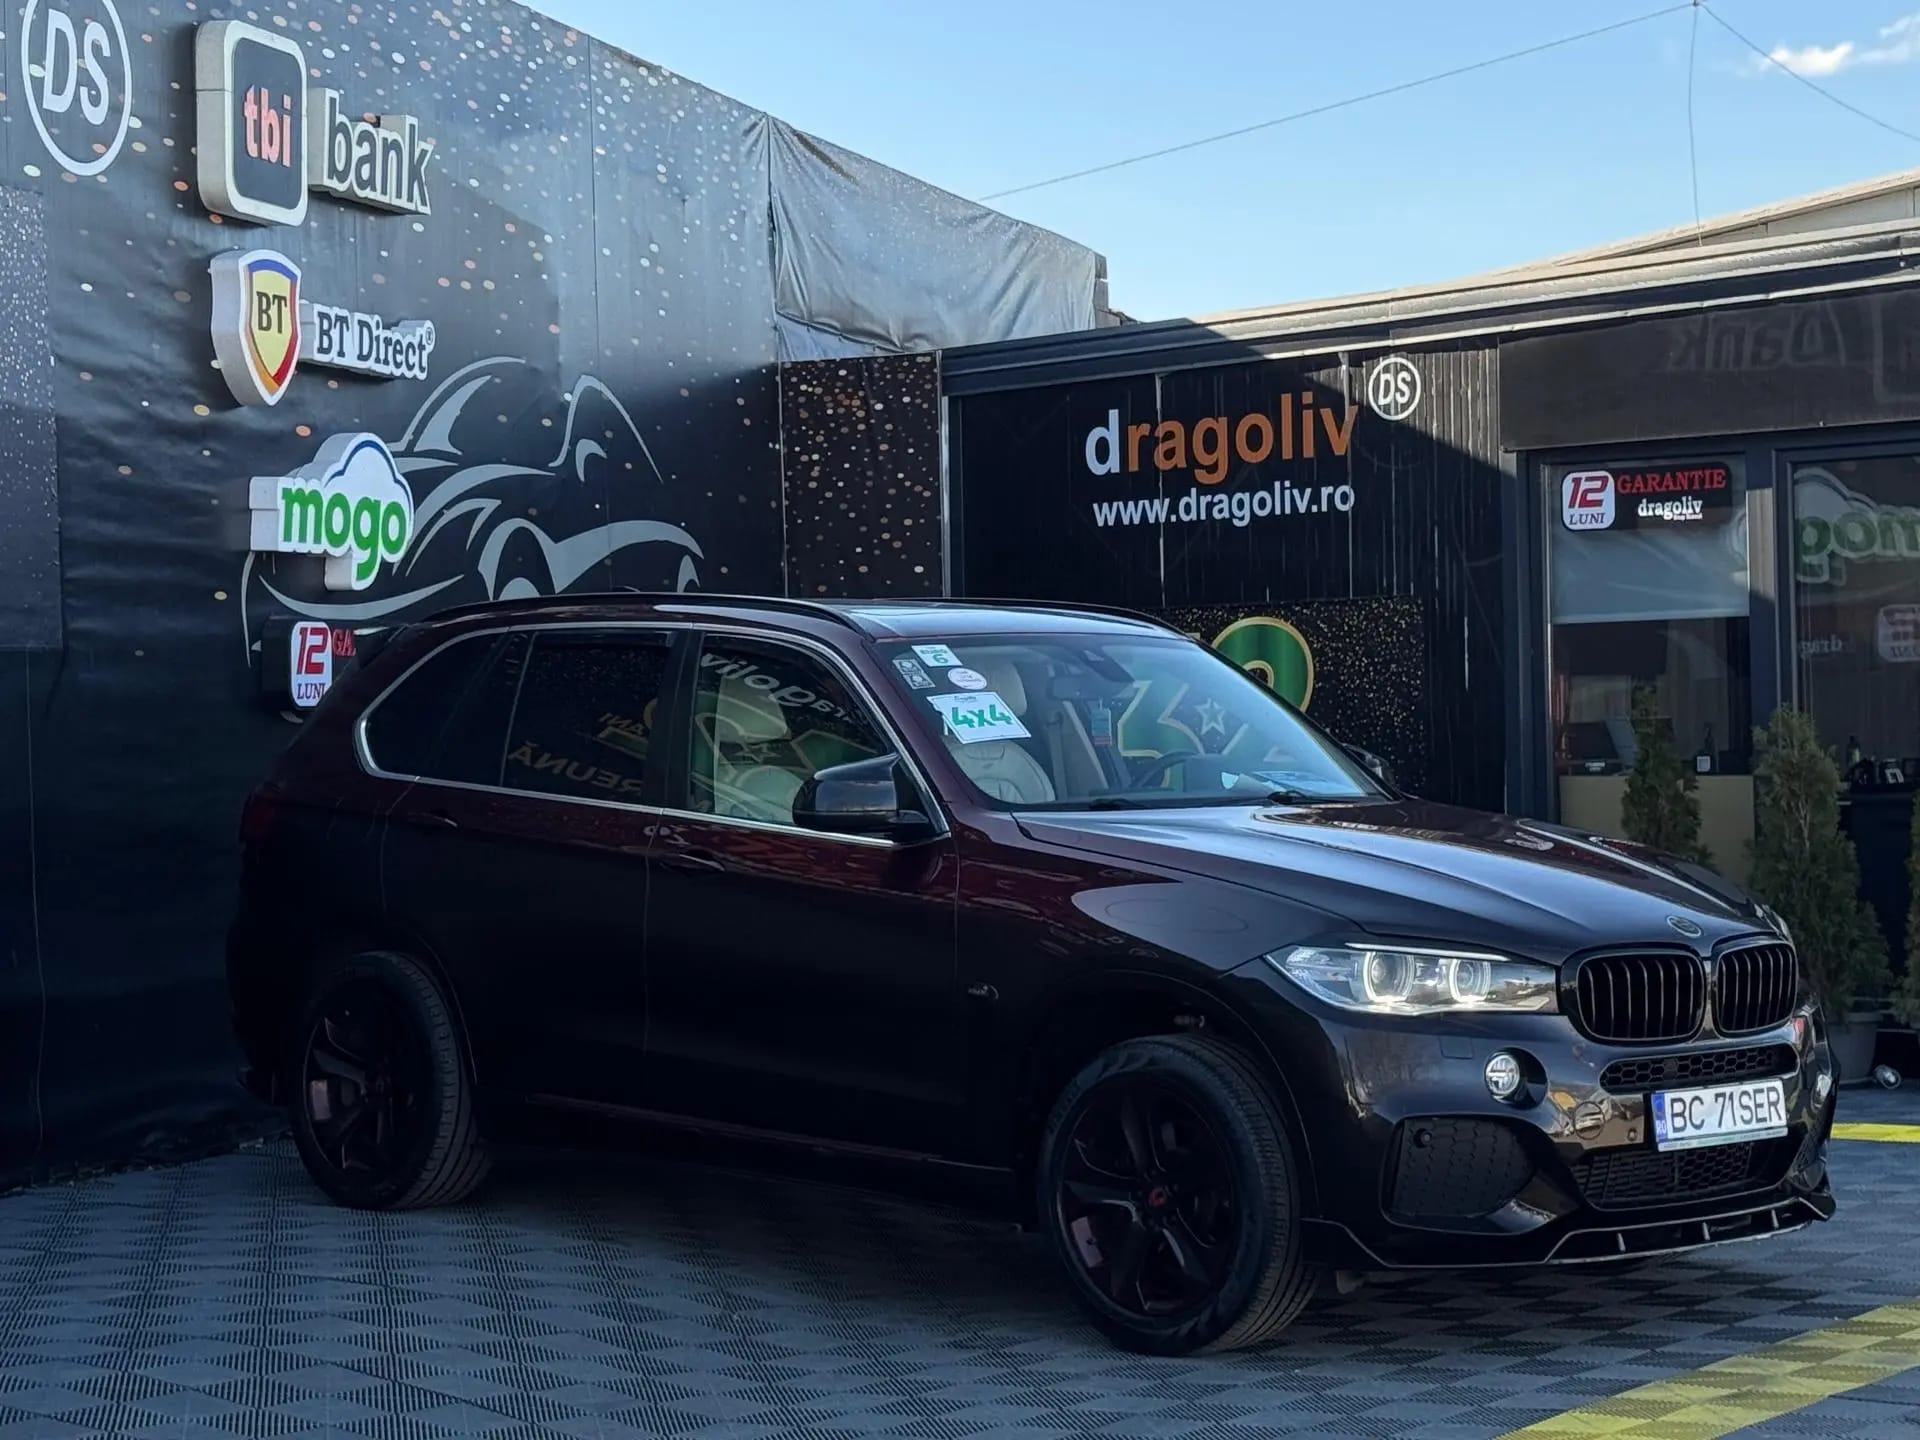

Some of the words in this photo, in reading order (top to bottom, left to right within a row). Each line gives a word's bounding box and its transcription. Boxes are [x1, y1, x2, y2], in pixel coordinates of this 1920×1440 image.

[43, 8, 111, 125] DS
[243, 85, 292, 167] tbi
[327, 96, 429, 207] bank
[256, 290, 288, 334] BT
[317, 311, 349, 358] BT
[1378, 371, 1411, 405] DS
[1085, 391, 1359, 485] dragoliv
[1093, 480, 1355, 527] www.dragoliv.ro
[1568, 475, 1609, 509] 12
[1617, 469, 1726, 494] GARANTIE
[1569, 512, 1606, 526] LUNI
[1638, 496, 1703, 520] dragoliv
[281, 486, 406, 581] mogo
[296, 627, 328, 675] 12
[332, 629, 357, 656] GA
[1670, 1094, 1705, 1133] BC
